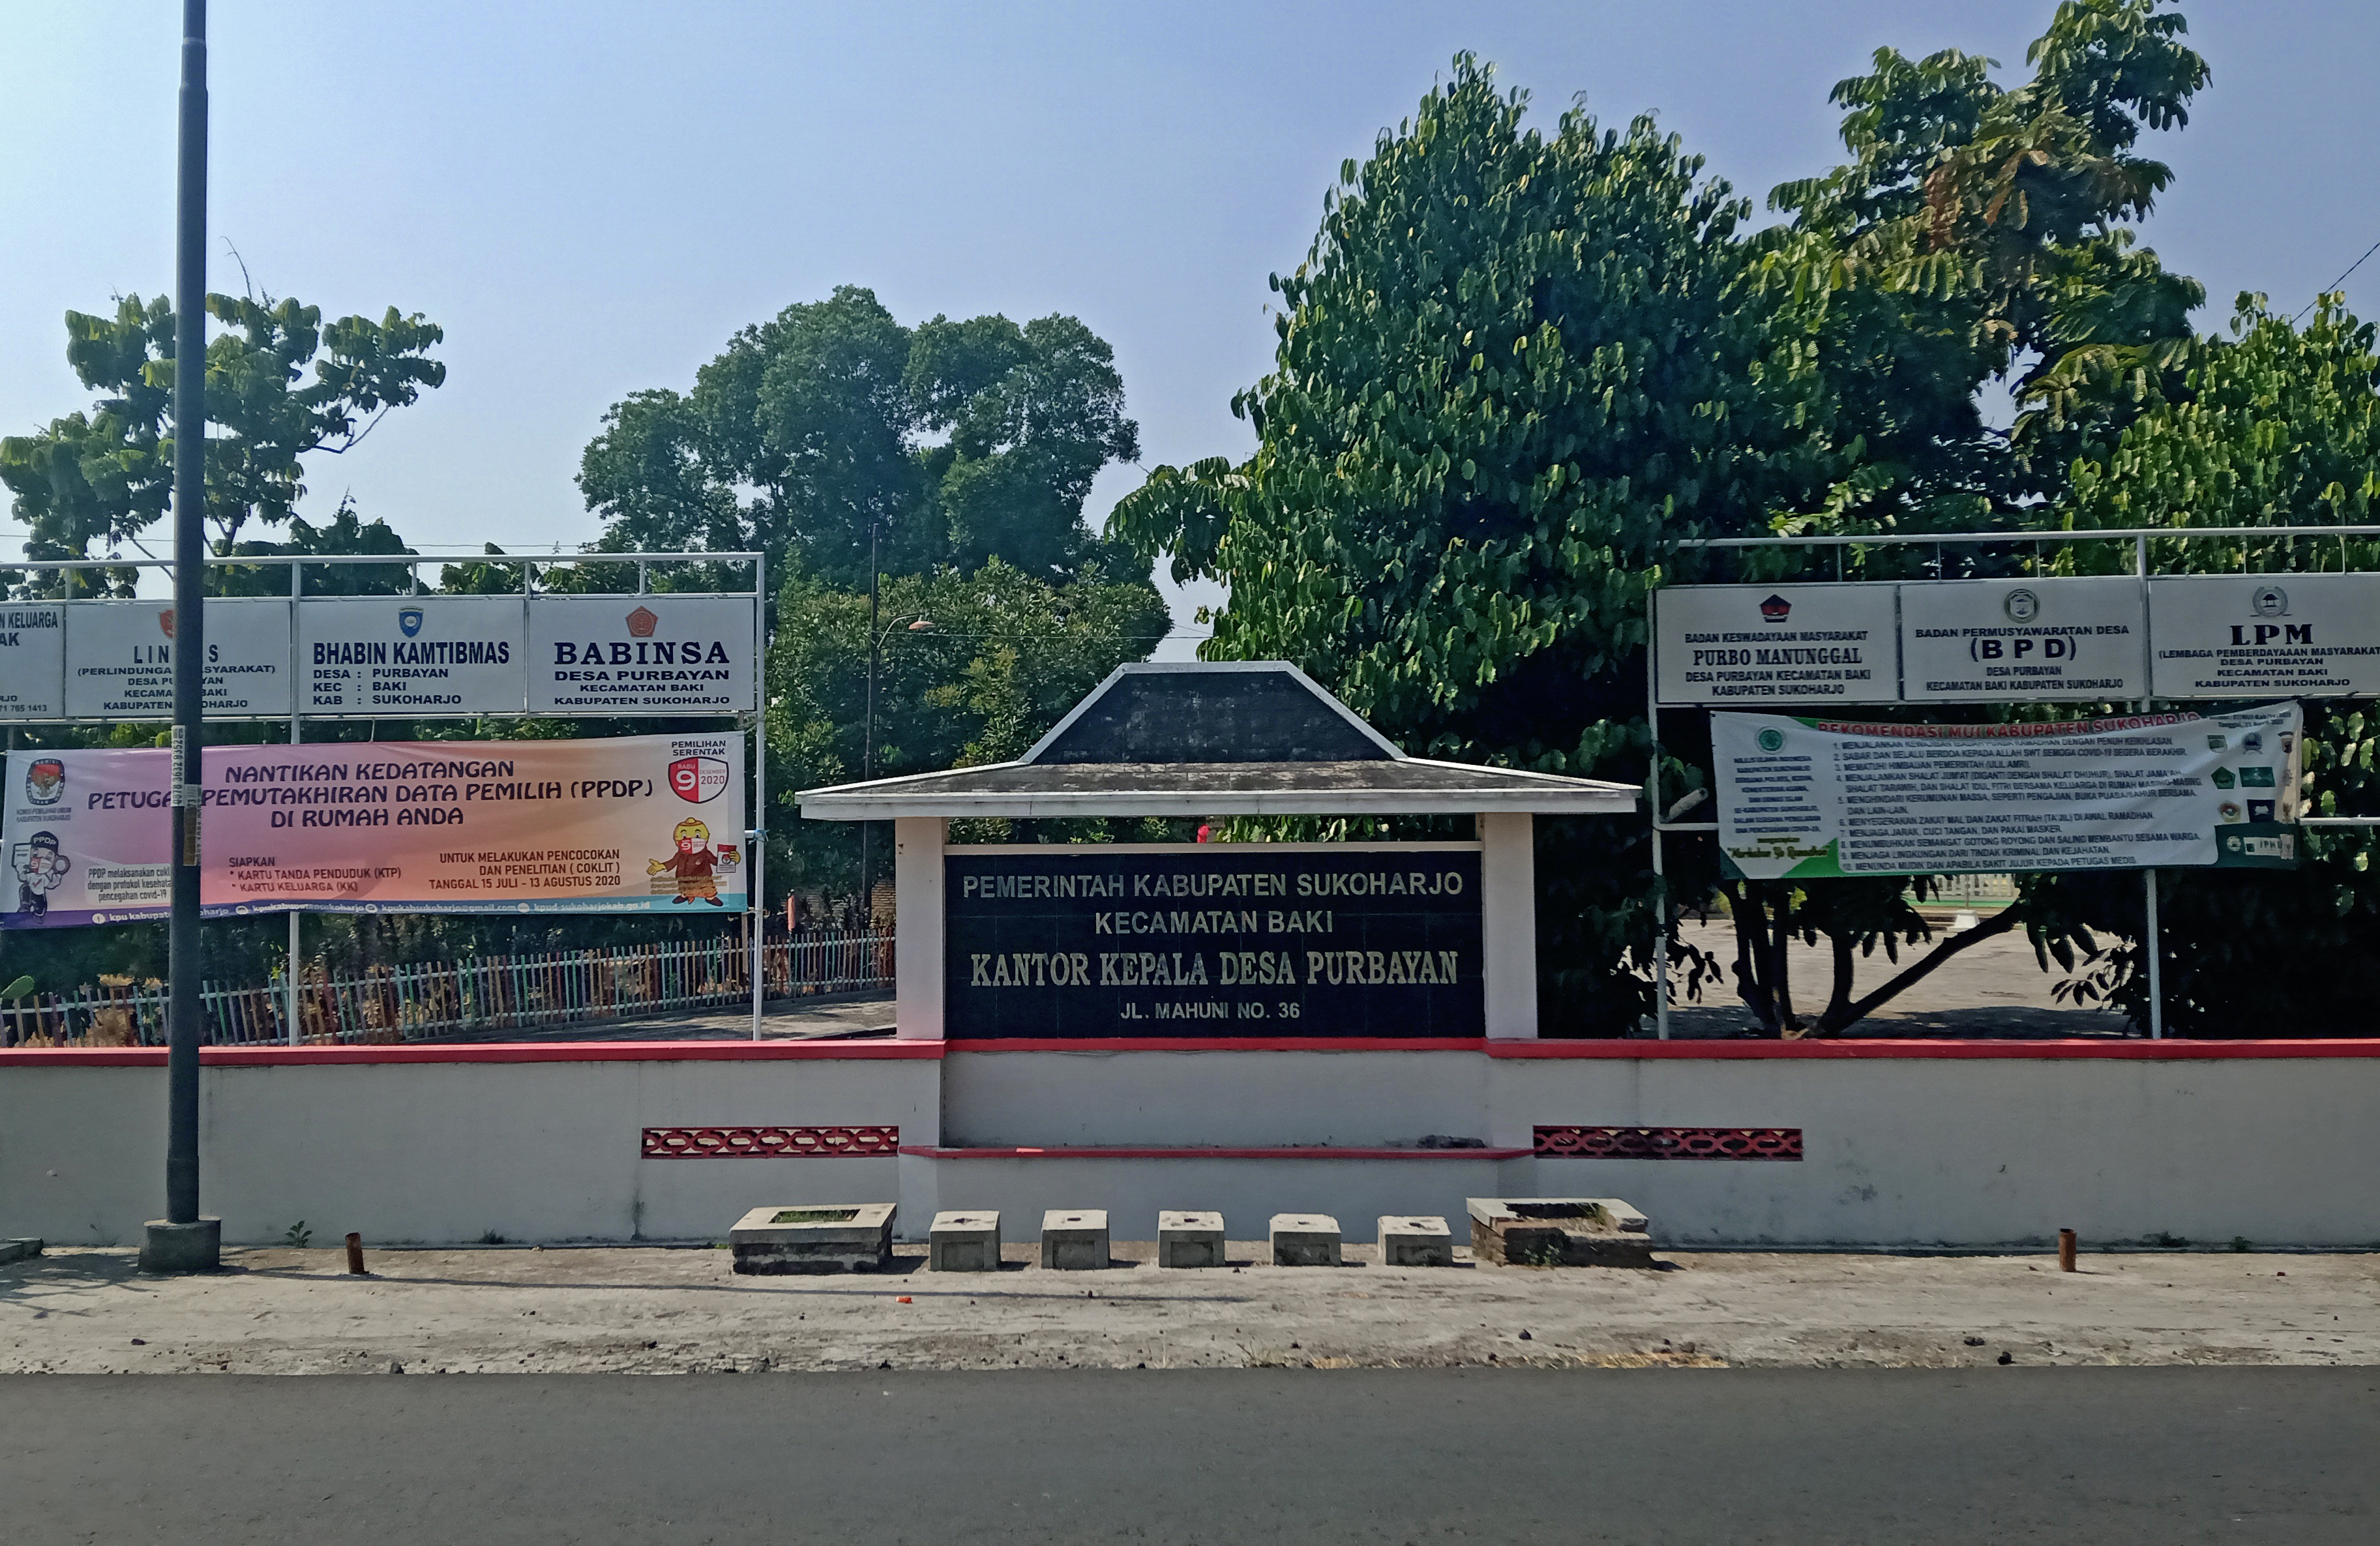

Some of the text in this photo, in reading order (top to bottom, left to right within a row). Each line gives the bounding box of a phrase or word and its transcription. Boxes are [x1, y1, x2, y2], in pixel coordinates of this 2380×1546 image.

[8, 612, 57, 628] KELUARGA
[1685, 633, 1719, 643] BADAN
[1800, 631, 1868, 642] MASYARAKAT
[1915, 625, 2130, 638] BADAN PERMUSYAWARATAN DESA
[2230, 623, 2313, 646] LPM
[313, 642, 509, 664] BHABIN KAMTIBMAS
[554, 642, 730, 664] BABINSA
[1693, 647, 1862, 666] PURBO MANUNGGAL
[78, 665, 276, 676] (PERLINDUNGA SYARAKAT)
[314, 668, 449, 678] DESA PURBAYAN
[555, 670, 729, 681] DESA PURBAYAN
[1686, 669, 1871, 682] DESA PURBAYAN KECAMATAN BAKI
[1986, 666, 2062, 676] DESA PURBAYAN
[314, 682, 406, 691] KEC BAKI
[1712, 684, 1845, 696] KABUPATEN SUKOHARJO
[1926, 679, 2123, 691] KECAMATAN BAKI KABUPATEN SUKOHARJO
[125, 689, 173, 698] KECAMA
[314, 695, 462, 704] KAB SUKOHARJO
[643, 696, 730, 705] SUKOHARJO
[1949, 726, 1980, 737] MUI
[1986, 722, 2089, 737] KABUPATEN
[226, 761, 514, 782] NANTIKAN KEDATANGAN
[676, 769, 696, 791] 9
[701, 775, 725, 784] 2020
[88, 780, 653, 809] PETUGA PEMUTAKHIRAN DATA PEMILIH (PPDP)
[271, 807, 464, 827] DI RUMAH ANDA
[33, 836, 57, 846] PPDP
[229, 857, 275, 867] SIAPKAN
[439, 849, 620, 863] UNTUK MELAKUKAN PENCOCOKAN
[88, 869, 106, 878] PPDP
[108, 868, 155, 878] melaksanakan
[238, 867, 402, 880] KARTU TANDA PENDUDUK (KTP)
[479, 863, 614, 876] DAN PENELITIAN COKLIT
[87, 878, 171, 891] dengan protokol kesehata
[241, 882, 358, 892] KARTU KELUARGA (KK)
[429, 875, 621, 890] TANGGAL 15 JULI 13 AGUSTUS 2020
[963, 872, 1463, 898] PEMERINTAH KABUPATEN SUKOHARJO
[98, 889, 167, 902] pencegahan covid-19
[109, 914, 127, 923] kpu
[1095, 910, 1333, 934] KECAMATAN BAKI
[971, 951, 1458, 987] KANTOR KEPALA DESA PURBAYAN
[1120, 1002, 1300, 1019] JL. MAHUNI NO. 36
